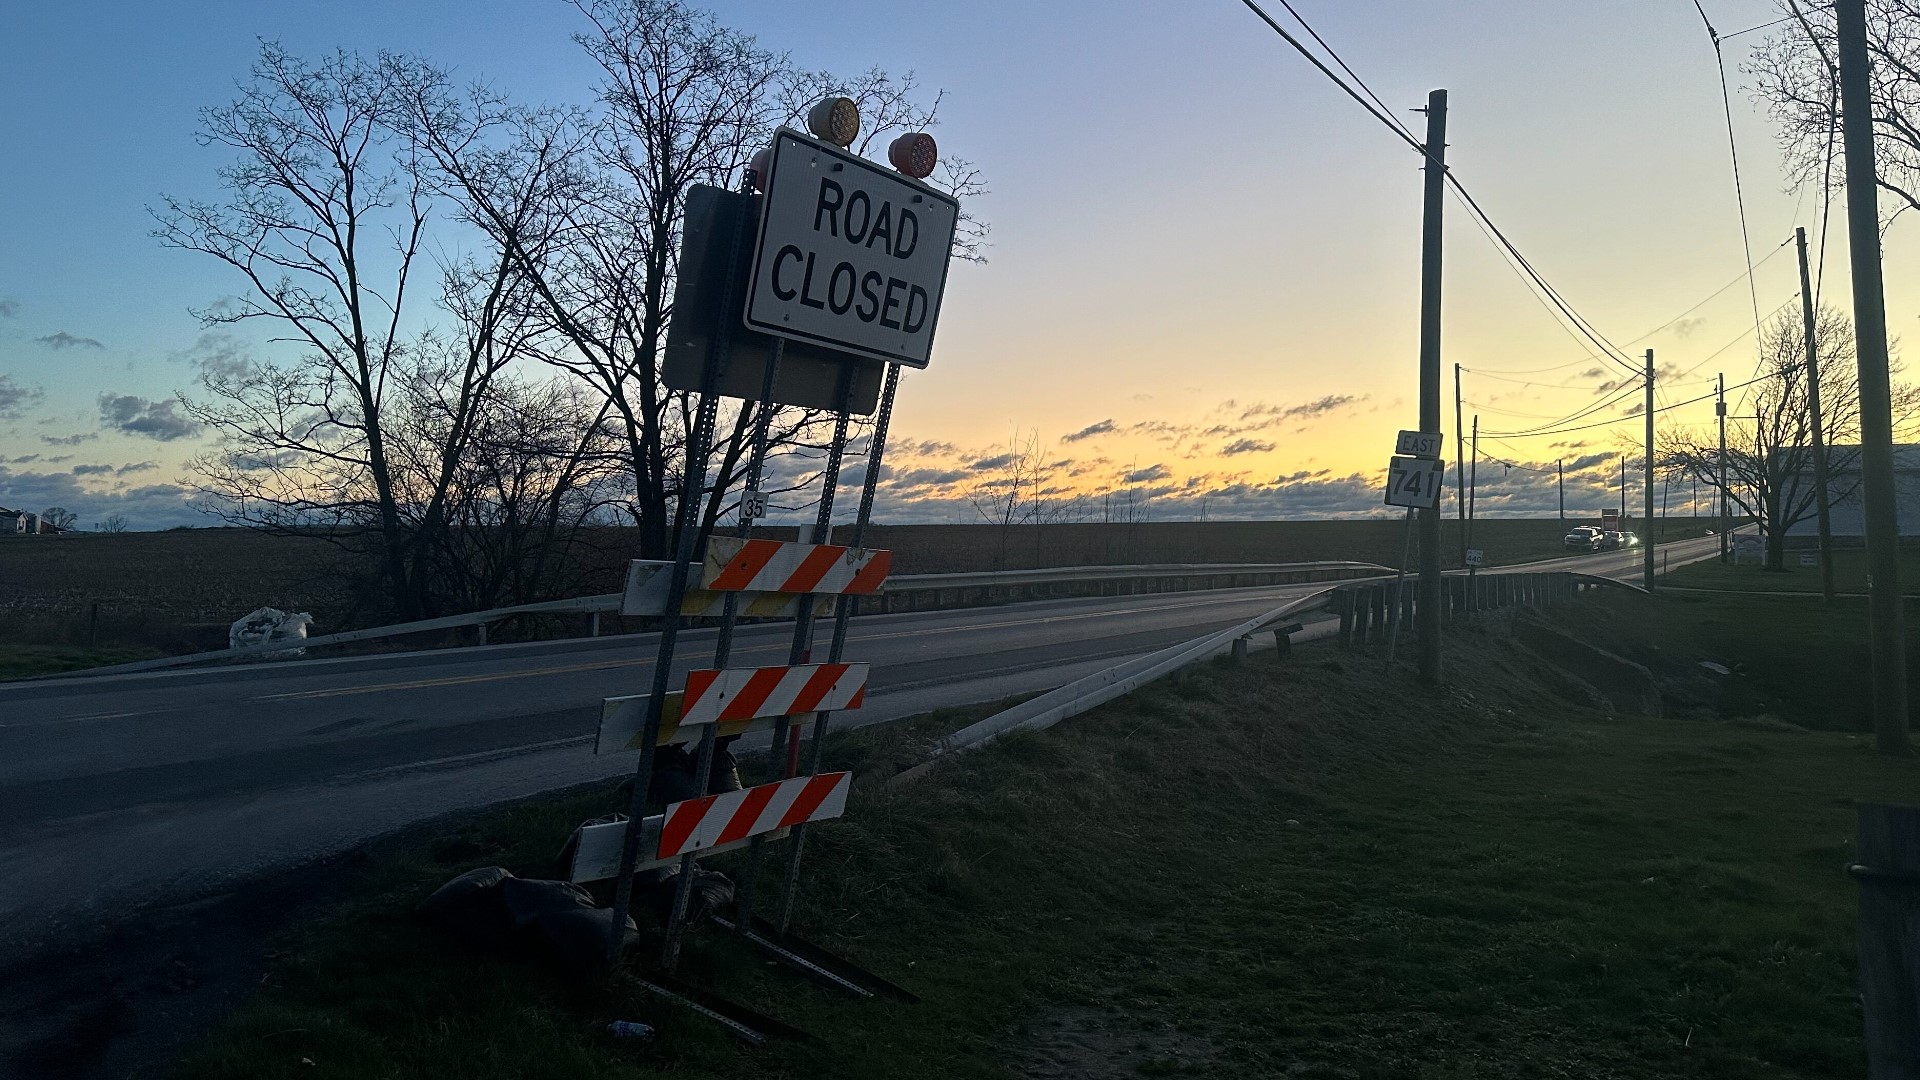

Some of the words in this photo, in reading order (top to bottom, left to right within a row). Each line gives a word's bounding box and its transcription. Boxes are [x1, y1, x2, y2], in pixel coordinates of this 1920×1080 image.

[813, 176, 919, 260] ROAD
[771, 244, 928, 334] CLOSED
[1402, 435, 1436, 453] EAST
[1392, 469, 1435, 499] 741
[745, 499, 763, 517] 35
